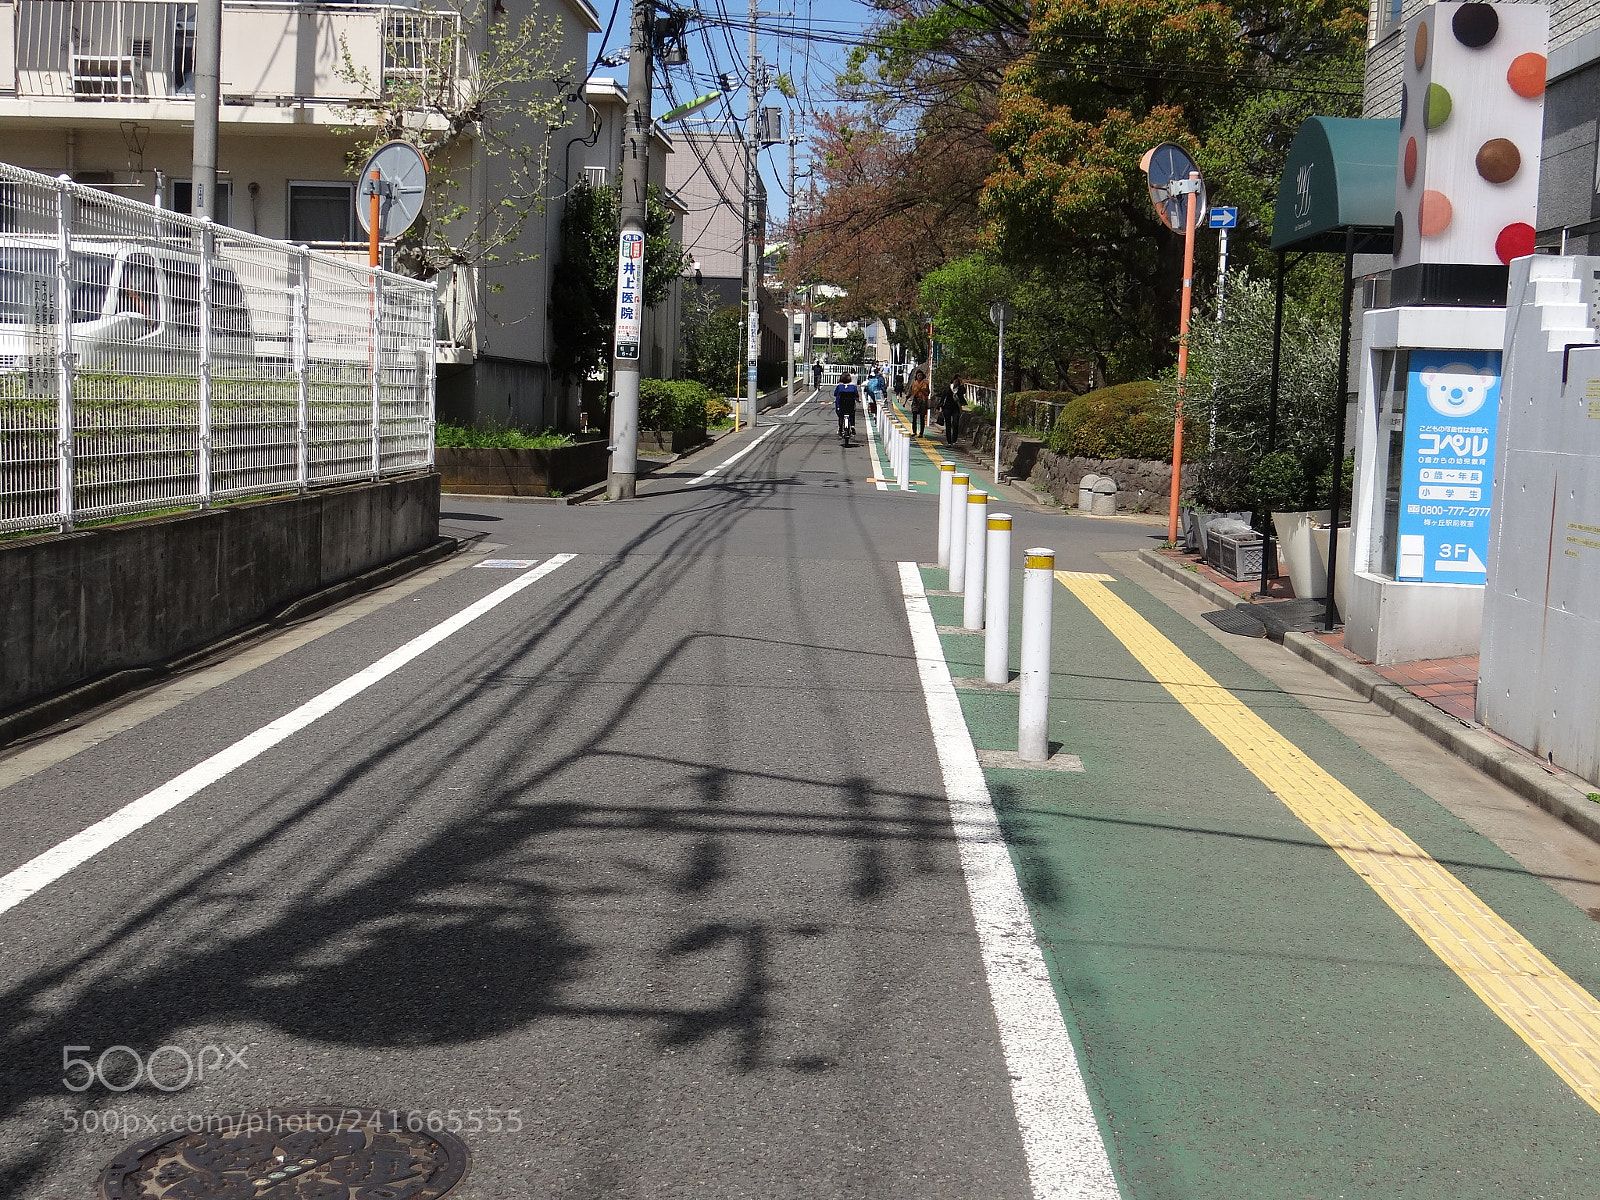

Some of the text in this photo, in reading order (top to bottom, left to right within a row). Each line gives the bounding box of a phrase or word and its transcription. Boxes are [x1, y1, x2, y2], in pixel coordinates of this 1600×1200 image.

[621, 262, 636, 320] 井上医院
[1418, 434, 1489, 457] コペル
[1422, 488, 1478, 499] 小学生
[1420, 505, 1491, 517] 0800-777-2777
[1438, 543, 1467, 558] 3F
